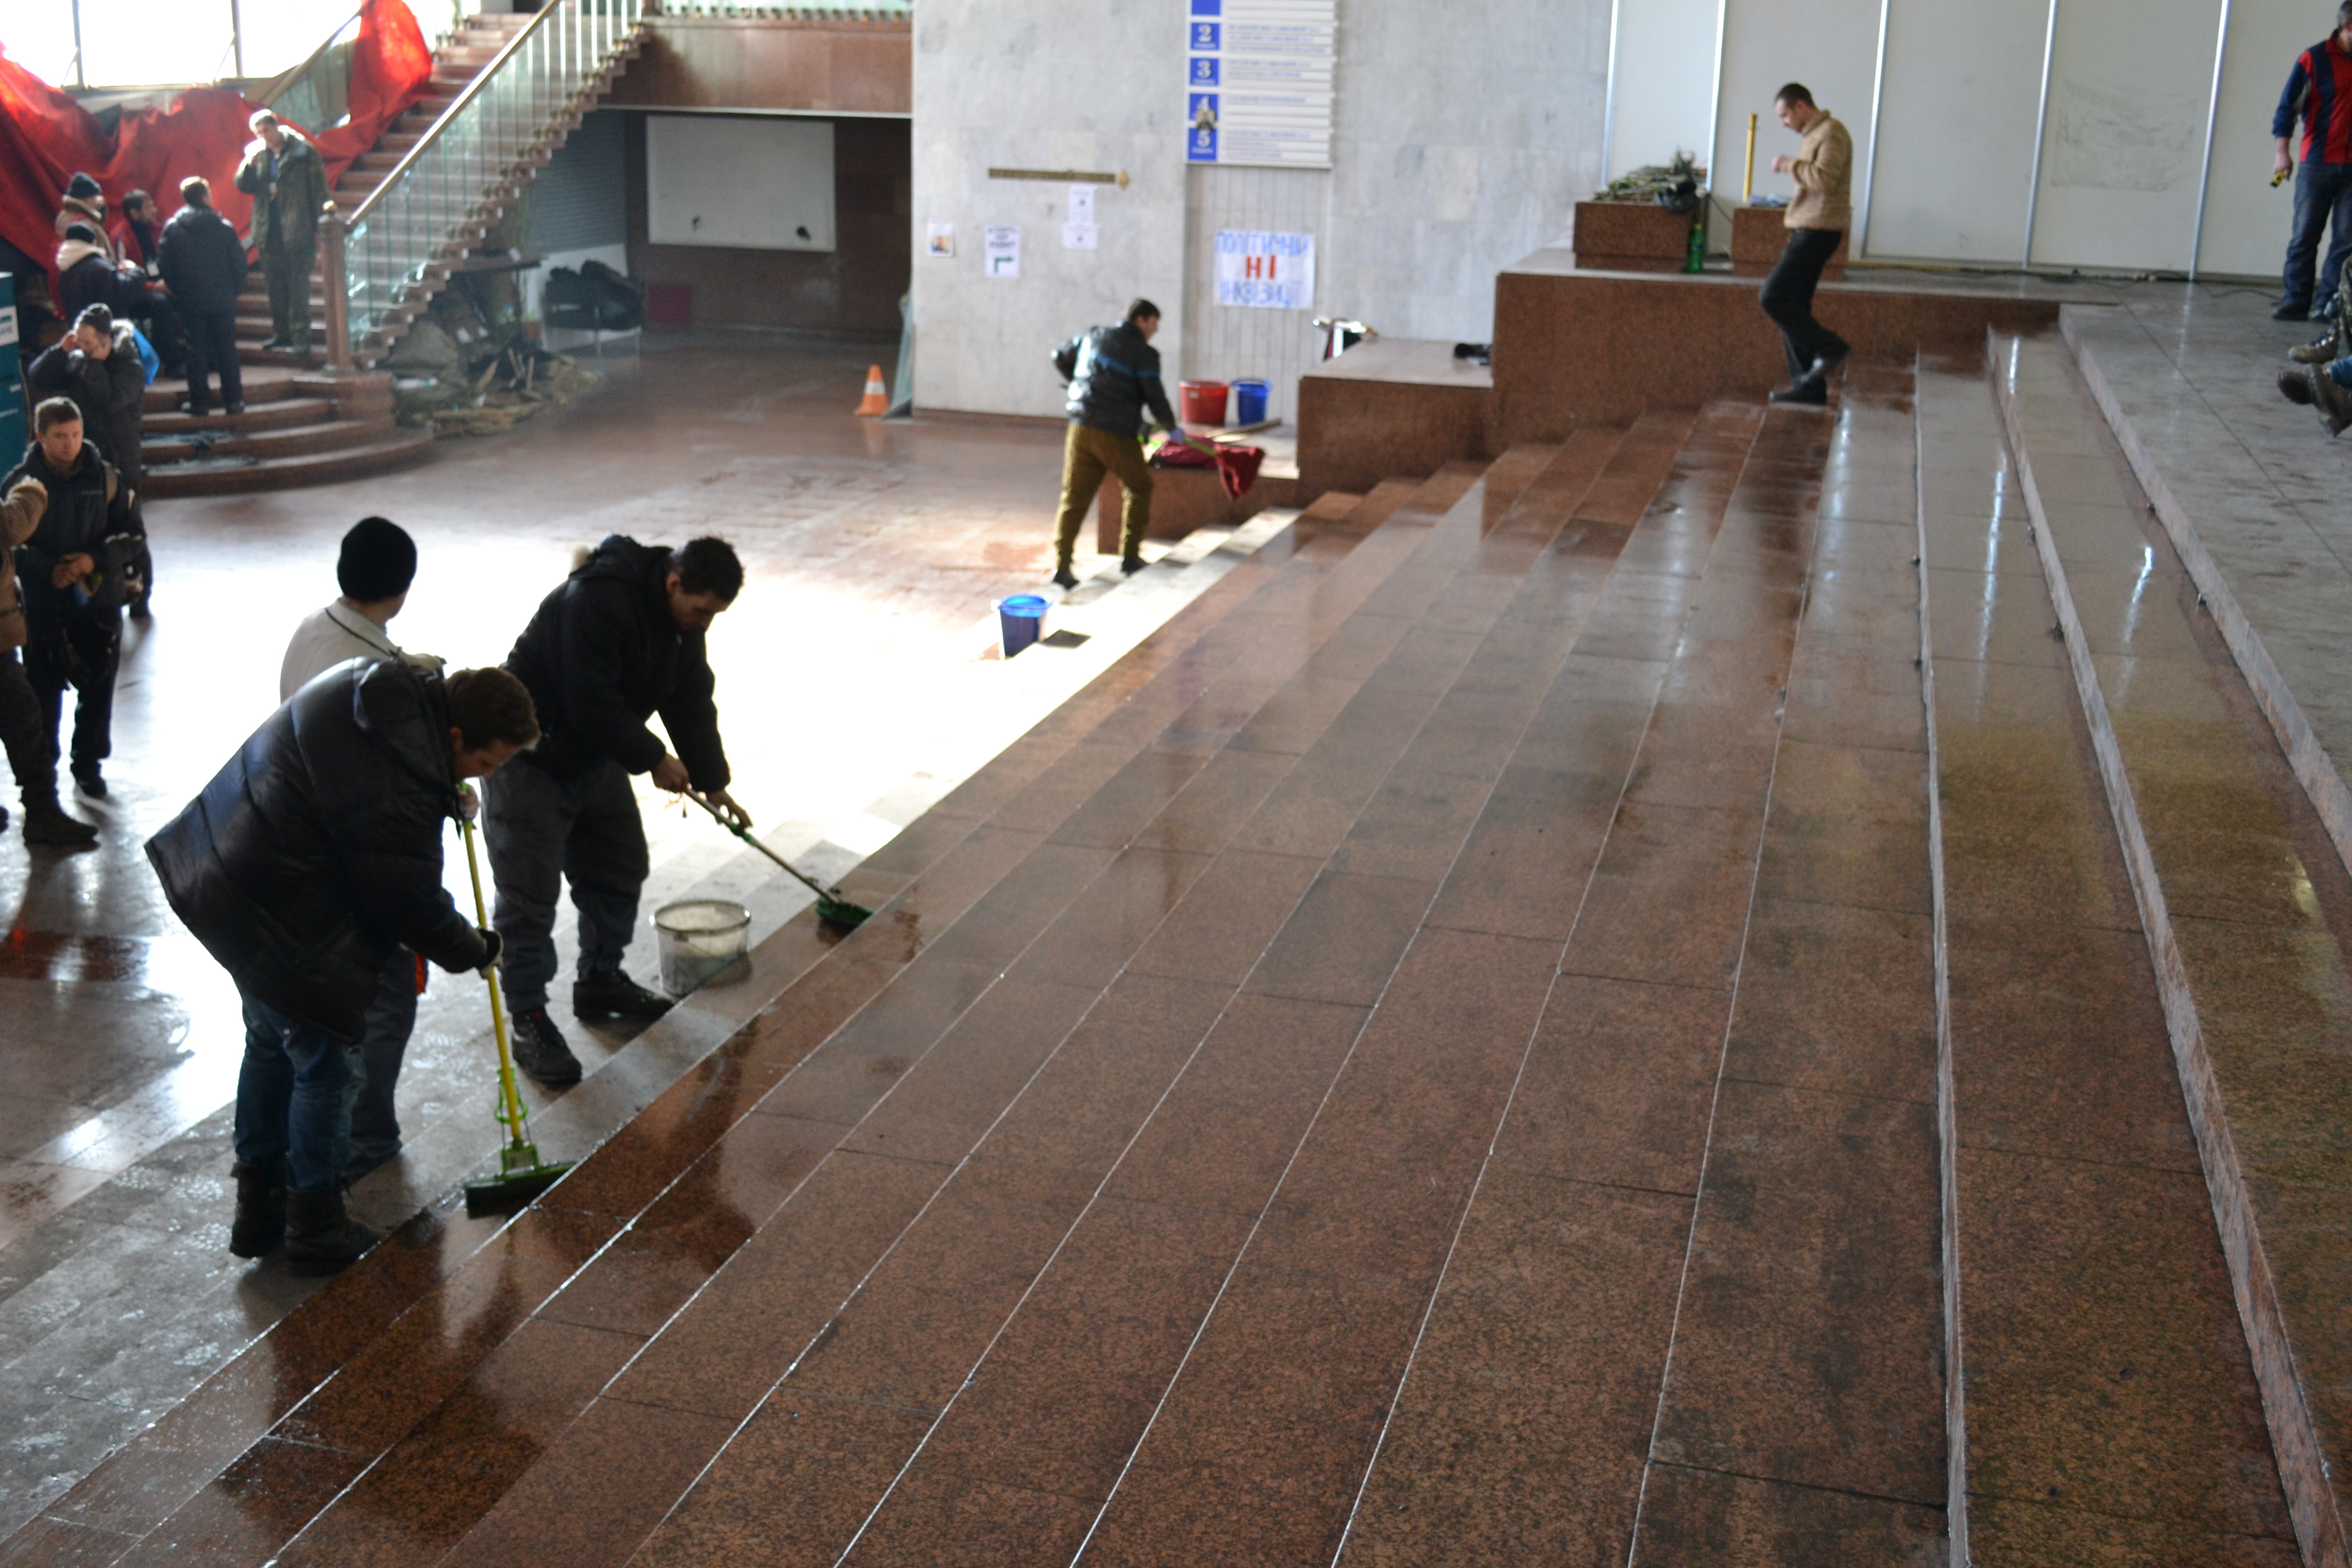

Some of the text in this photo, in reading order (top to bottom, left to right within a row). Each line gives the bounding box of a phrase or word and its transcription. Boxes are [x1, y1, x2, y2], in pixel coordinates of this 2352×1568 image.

[1198, 24, 1212, 42] 2
[1196, 60, 1212, 79] 3
[1196, 128, 1211, 147] 5
[1245, 255, 1276, 280] НІ
